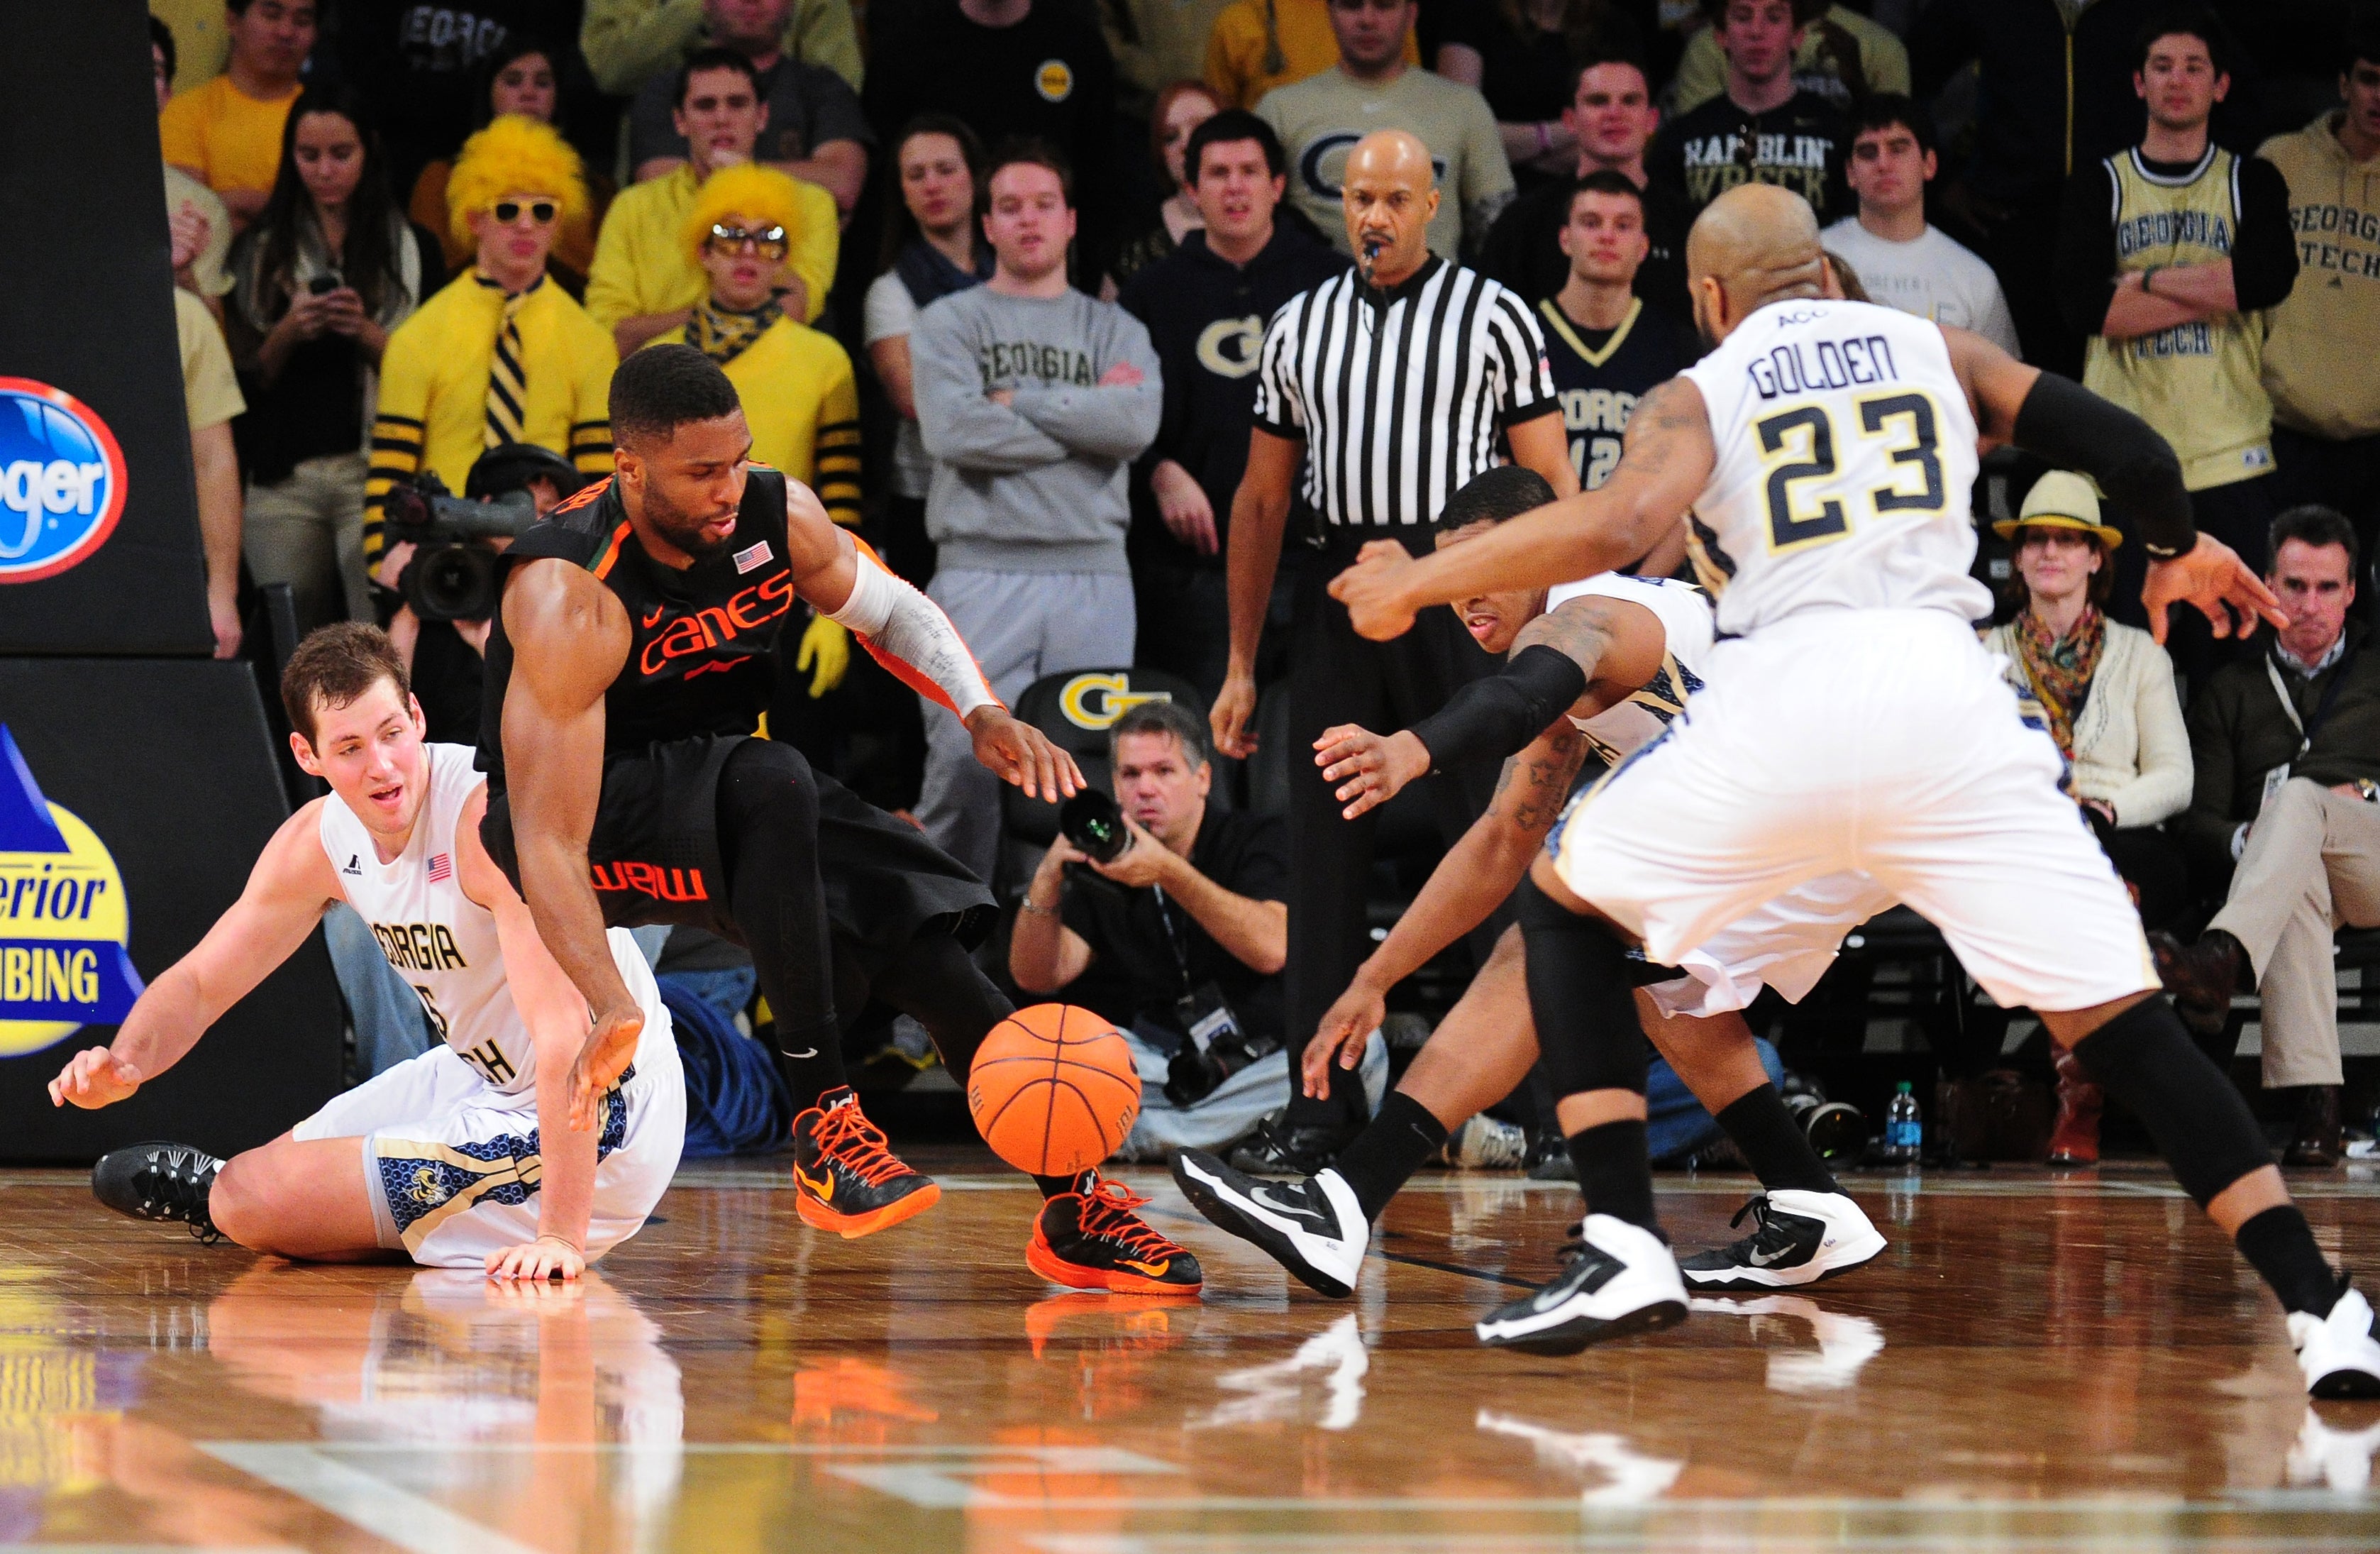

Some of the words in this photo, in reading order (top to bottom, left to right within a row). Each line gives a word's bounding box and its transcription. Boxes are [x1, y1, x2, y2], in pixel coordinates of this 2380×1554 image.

[2118, 210, 2230, 258] GEOGIA
[2288, 204, 2380, 246] GEORG
[2301, 241, 2380, 277] TECH
[1778, 308, 1829, 329] ACC
[1748, 335, 1899, 399] GOLDEN
[1752, 390, 1947, 555] 23
[0, 460, 104, 558] ger
[367, 921, 468, 971] EORGIA
[0, 947, 99, 1003] BING
